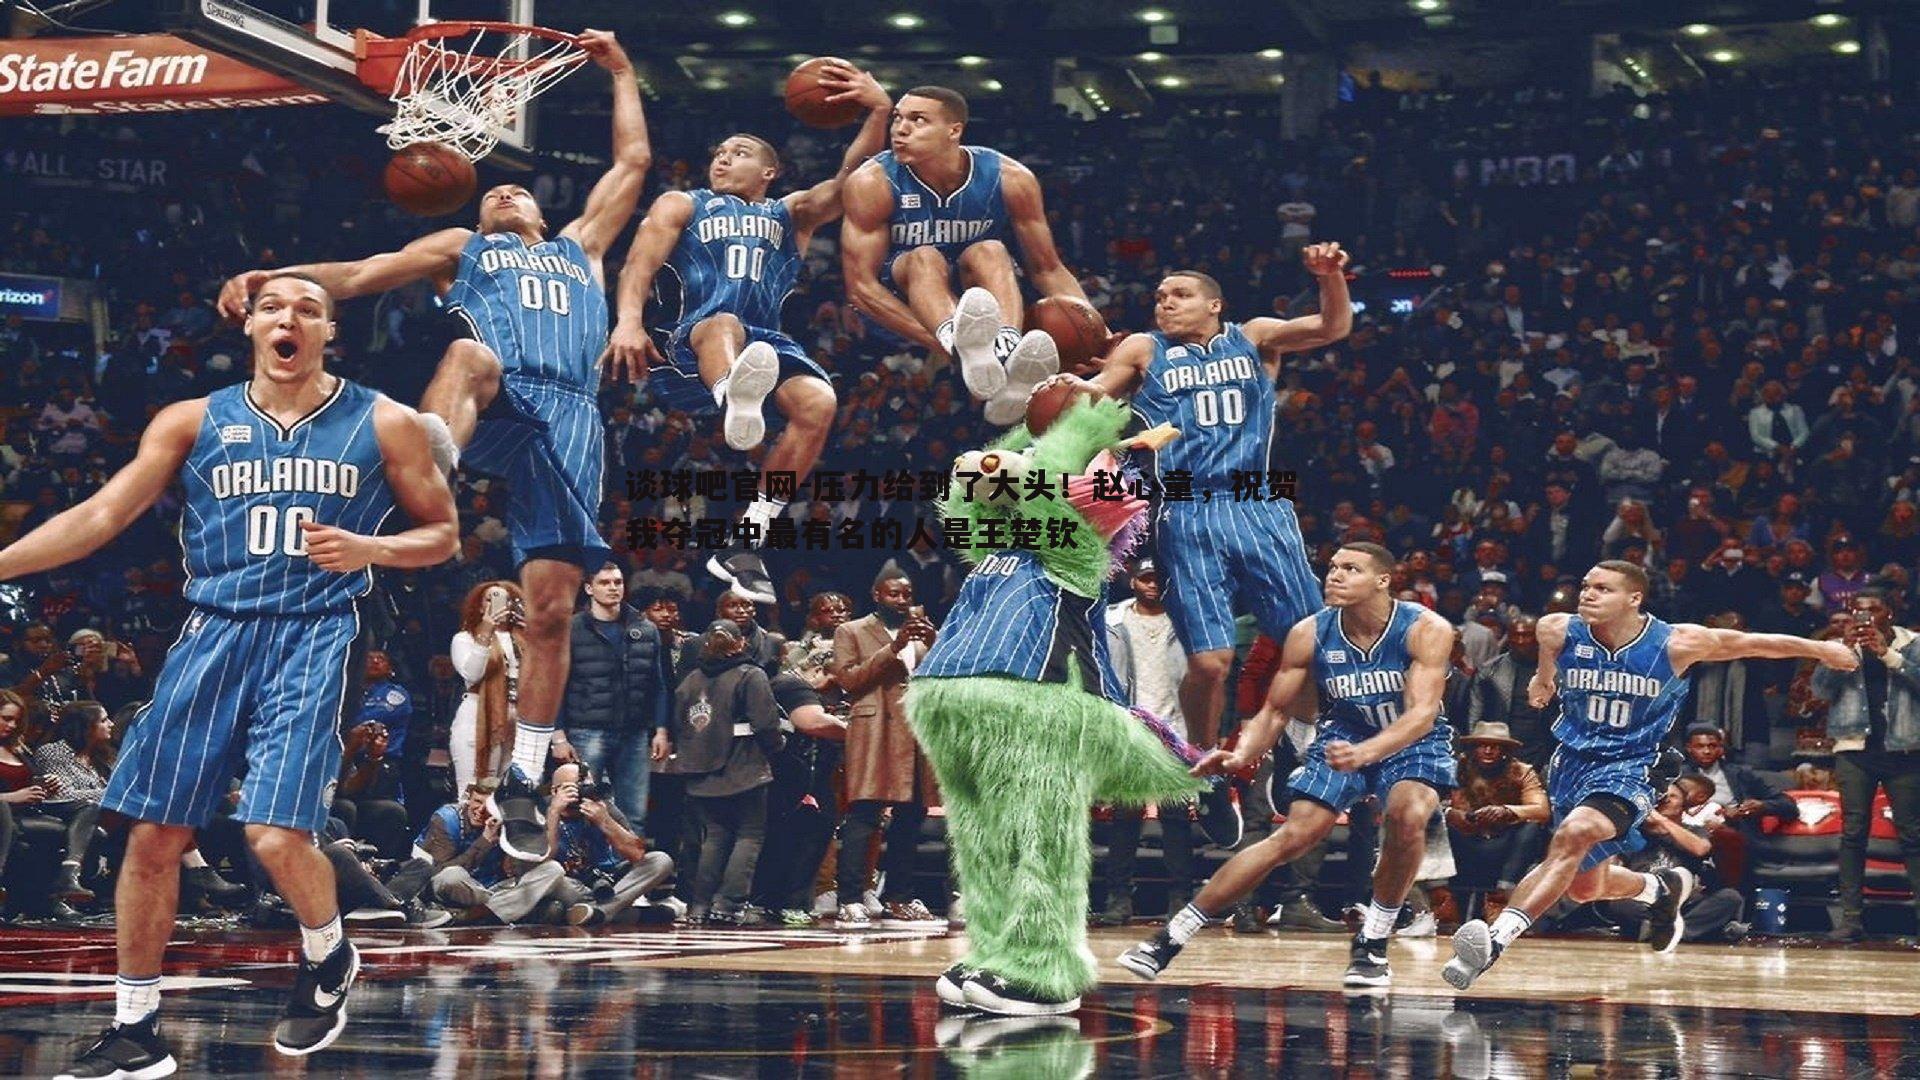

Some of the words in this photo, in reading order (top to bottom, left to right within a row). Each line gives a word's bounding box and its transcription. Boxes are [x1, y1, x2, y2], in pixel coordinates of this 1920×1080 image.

[22, 151, 71, 176] ALL
[98, 158, 167, 187] STAR
[697, 214, 784, 251] ORLANDO
[481, 249, 590, 287] ORLANDO
[727, 244, 765, 283] 00
[519, 274, 571, 316] 00
[1163, 356, 1257, 395] ORLAND
[1195, 388, 1244, 427] 00
[211, 457, 360, 500] ORLANDO
[248, 504, 315, 557] 00
[1566, 668, 1661, 698] ORLANDO
[1587, 695, 1631, 729] 00
